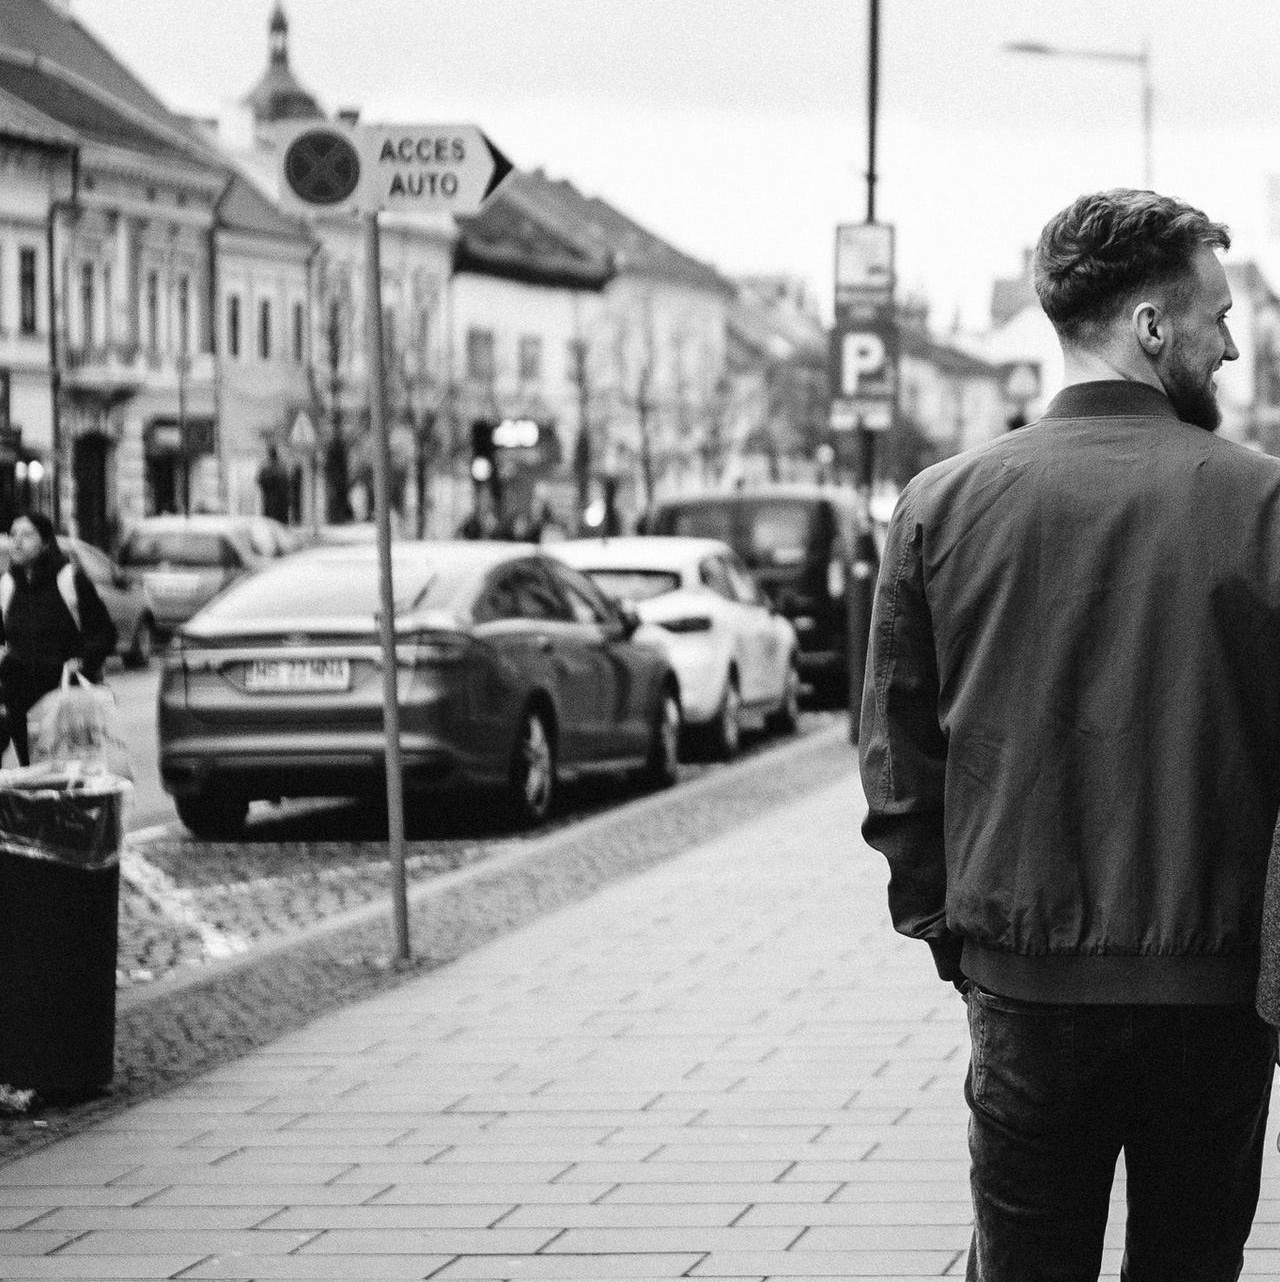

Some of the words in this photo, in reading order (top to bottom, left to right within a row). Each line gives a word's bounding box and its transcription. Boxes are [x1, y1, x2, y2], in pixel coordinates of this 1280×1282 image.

[379, 137, 467, 164] ACCES
[388, 172, 459, 198] AUTO
[842, 332, 885, 396] P
